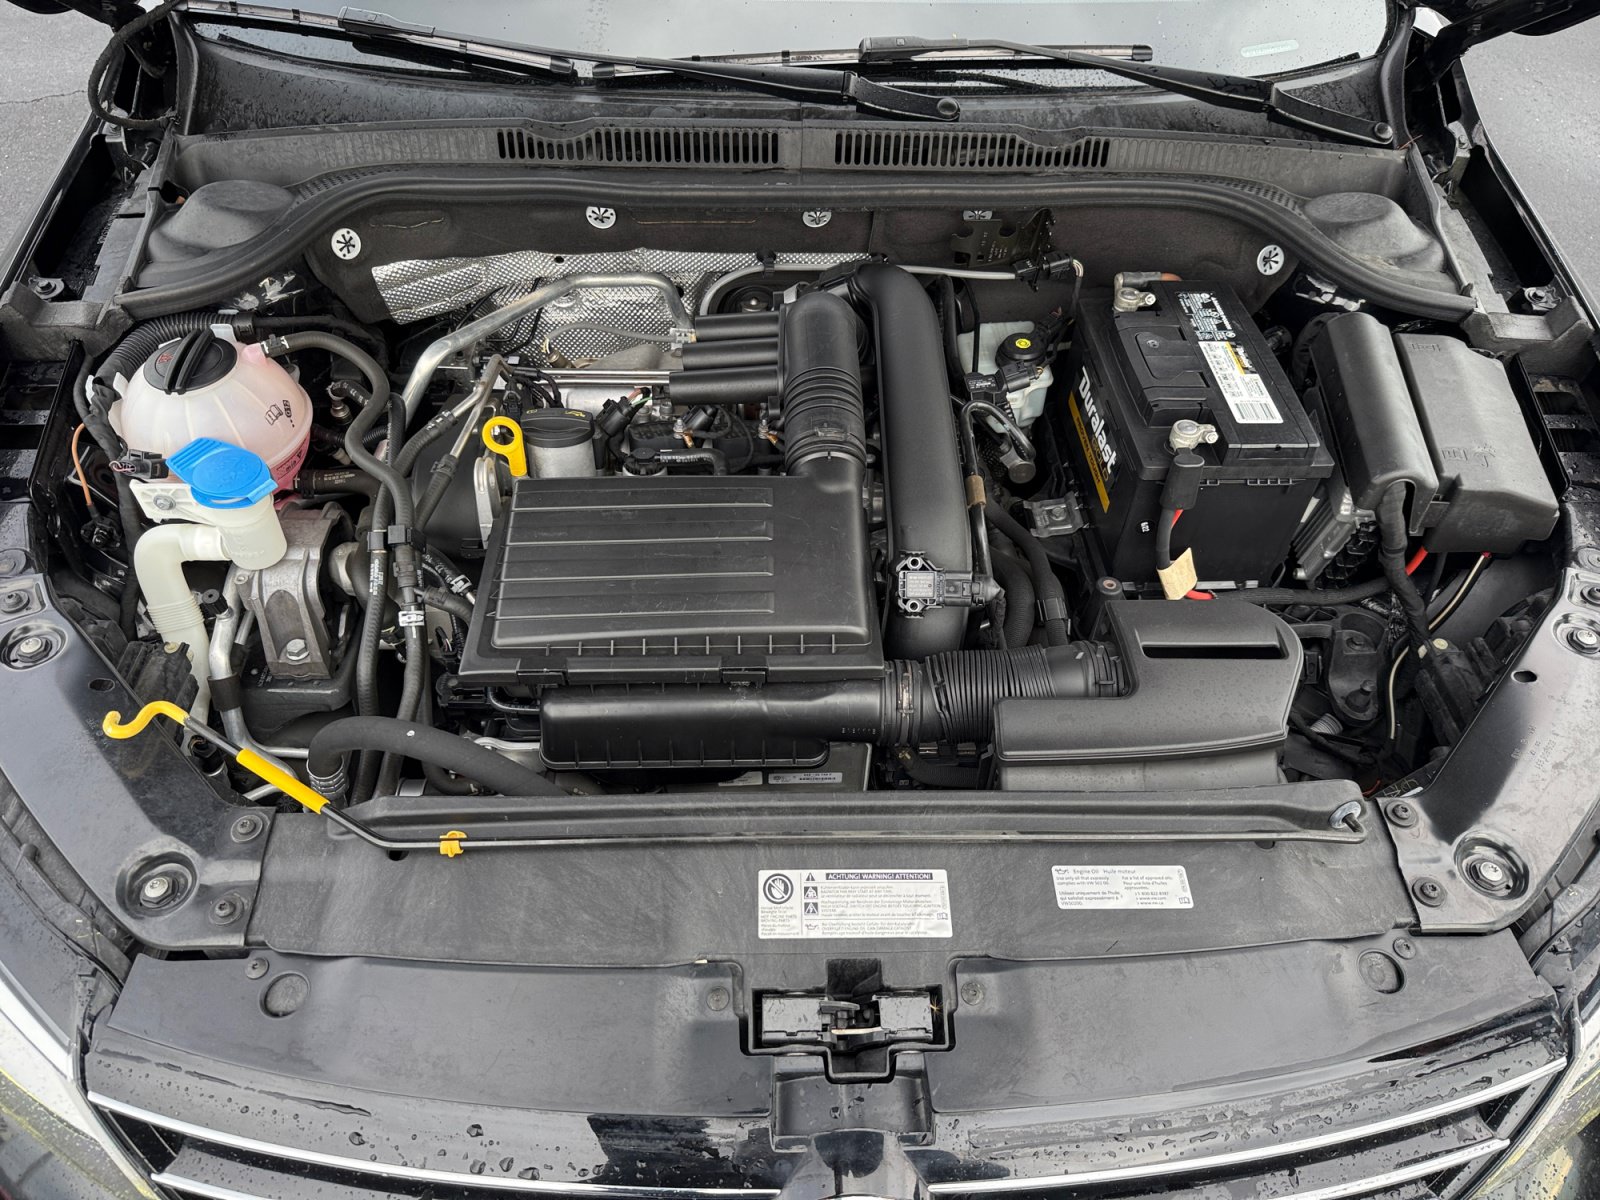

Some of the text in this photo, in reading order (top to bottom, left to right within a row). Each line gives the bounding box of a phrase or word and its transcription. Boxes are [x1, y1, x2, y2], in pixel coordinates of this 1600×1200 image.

[1075, 416, 1101, 483] PROVEN TOUGH
[1079, 366, 1116, 474] Duralast
[1092, 436, 1108, 481] GOLD
